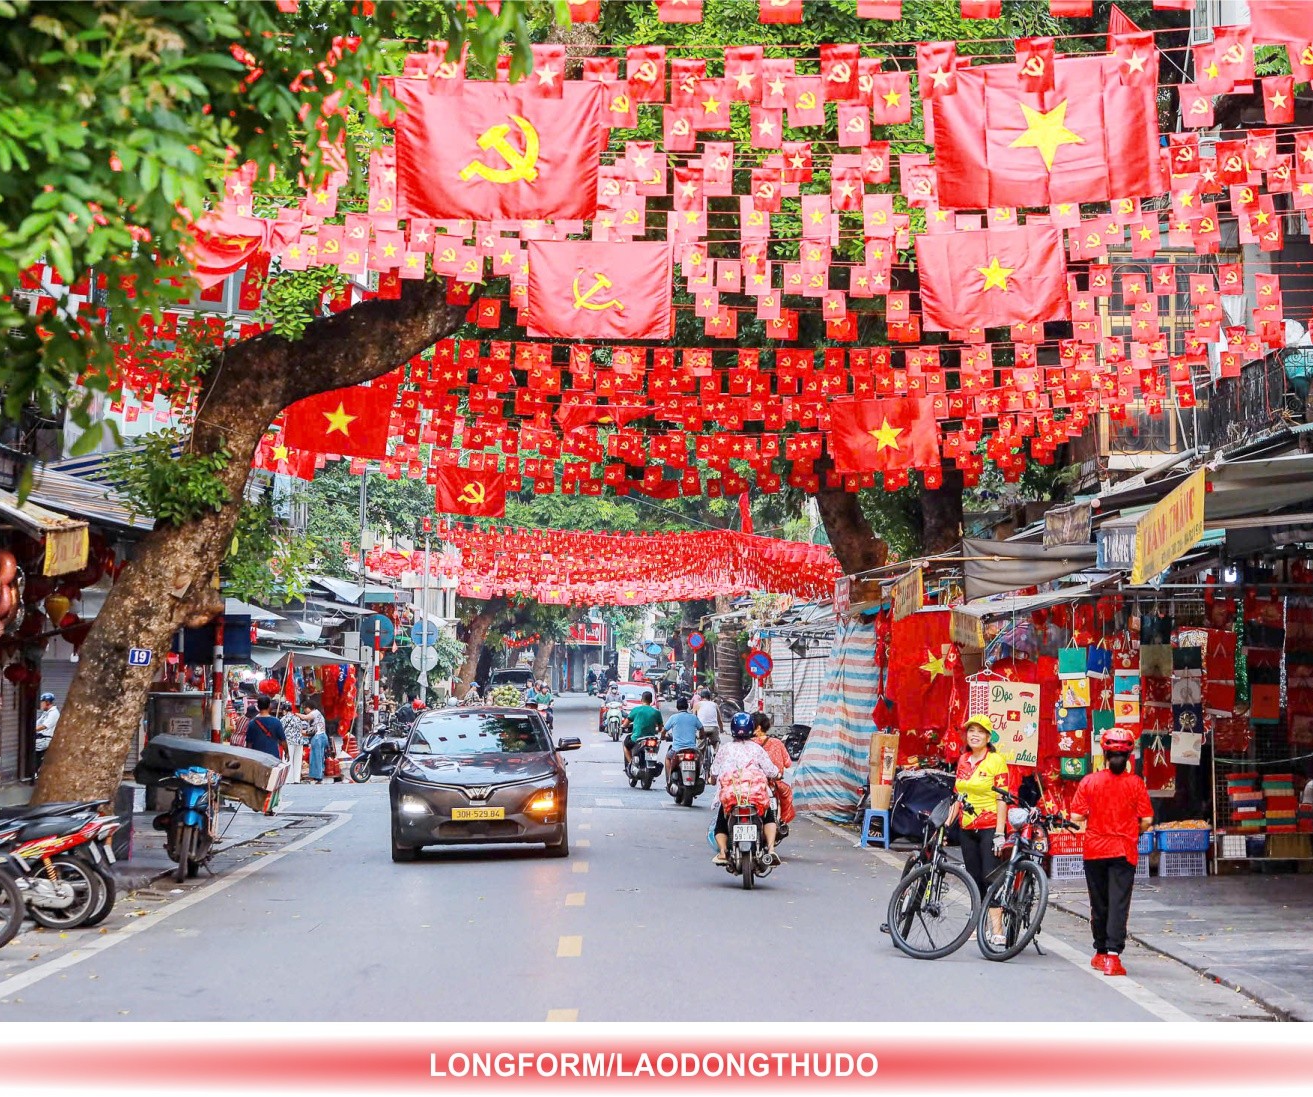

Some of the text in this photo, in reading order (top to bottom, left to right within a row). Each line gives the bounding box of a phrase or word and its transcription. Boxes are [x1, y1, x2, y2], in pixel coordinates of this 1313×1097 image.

[134, 651, 147, 664] 19
[991, 685, 1013, 703] Độc
[1022, 701, 1037, 717] lập
[1012, 730, 1024, 742] do
[1015, 749, 1037, 763] phúc
